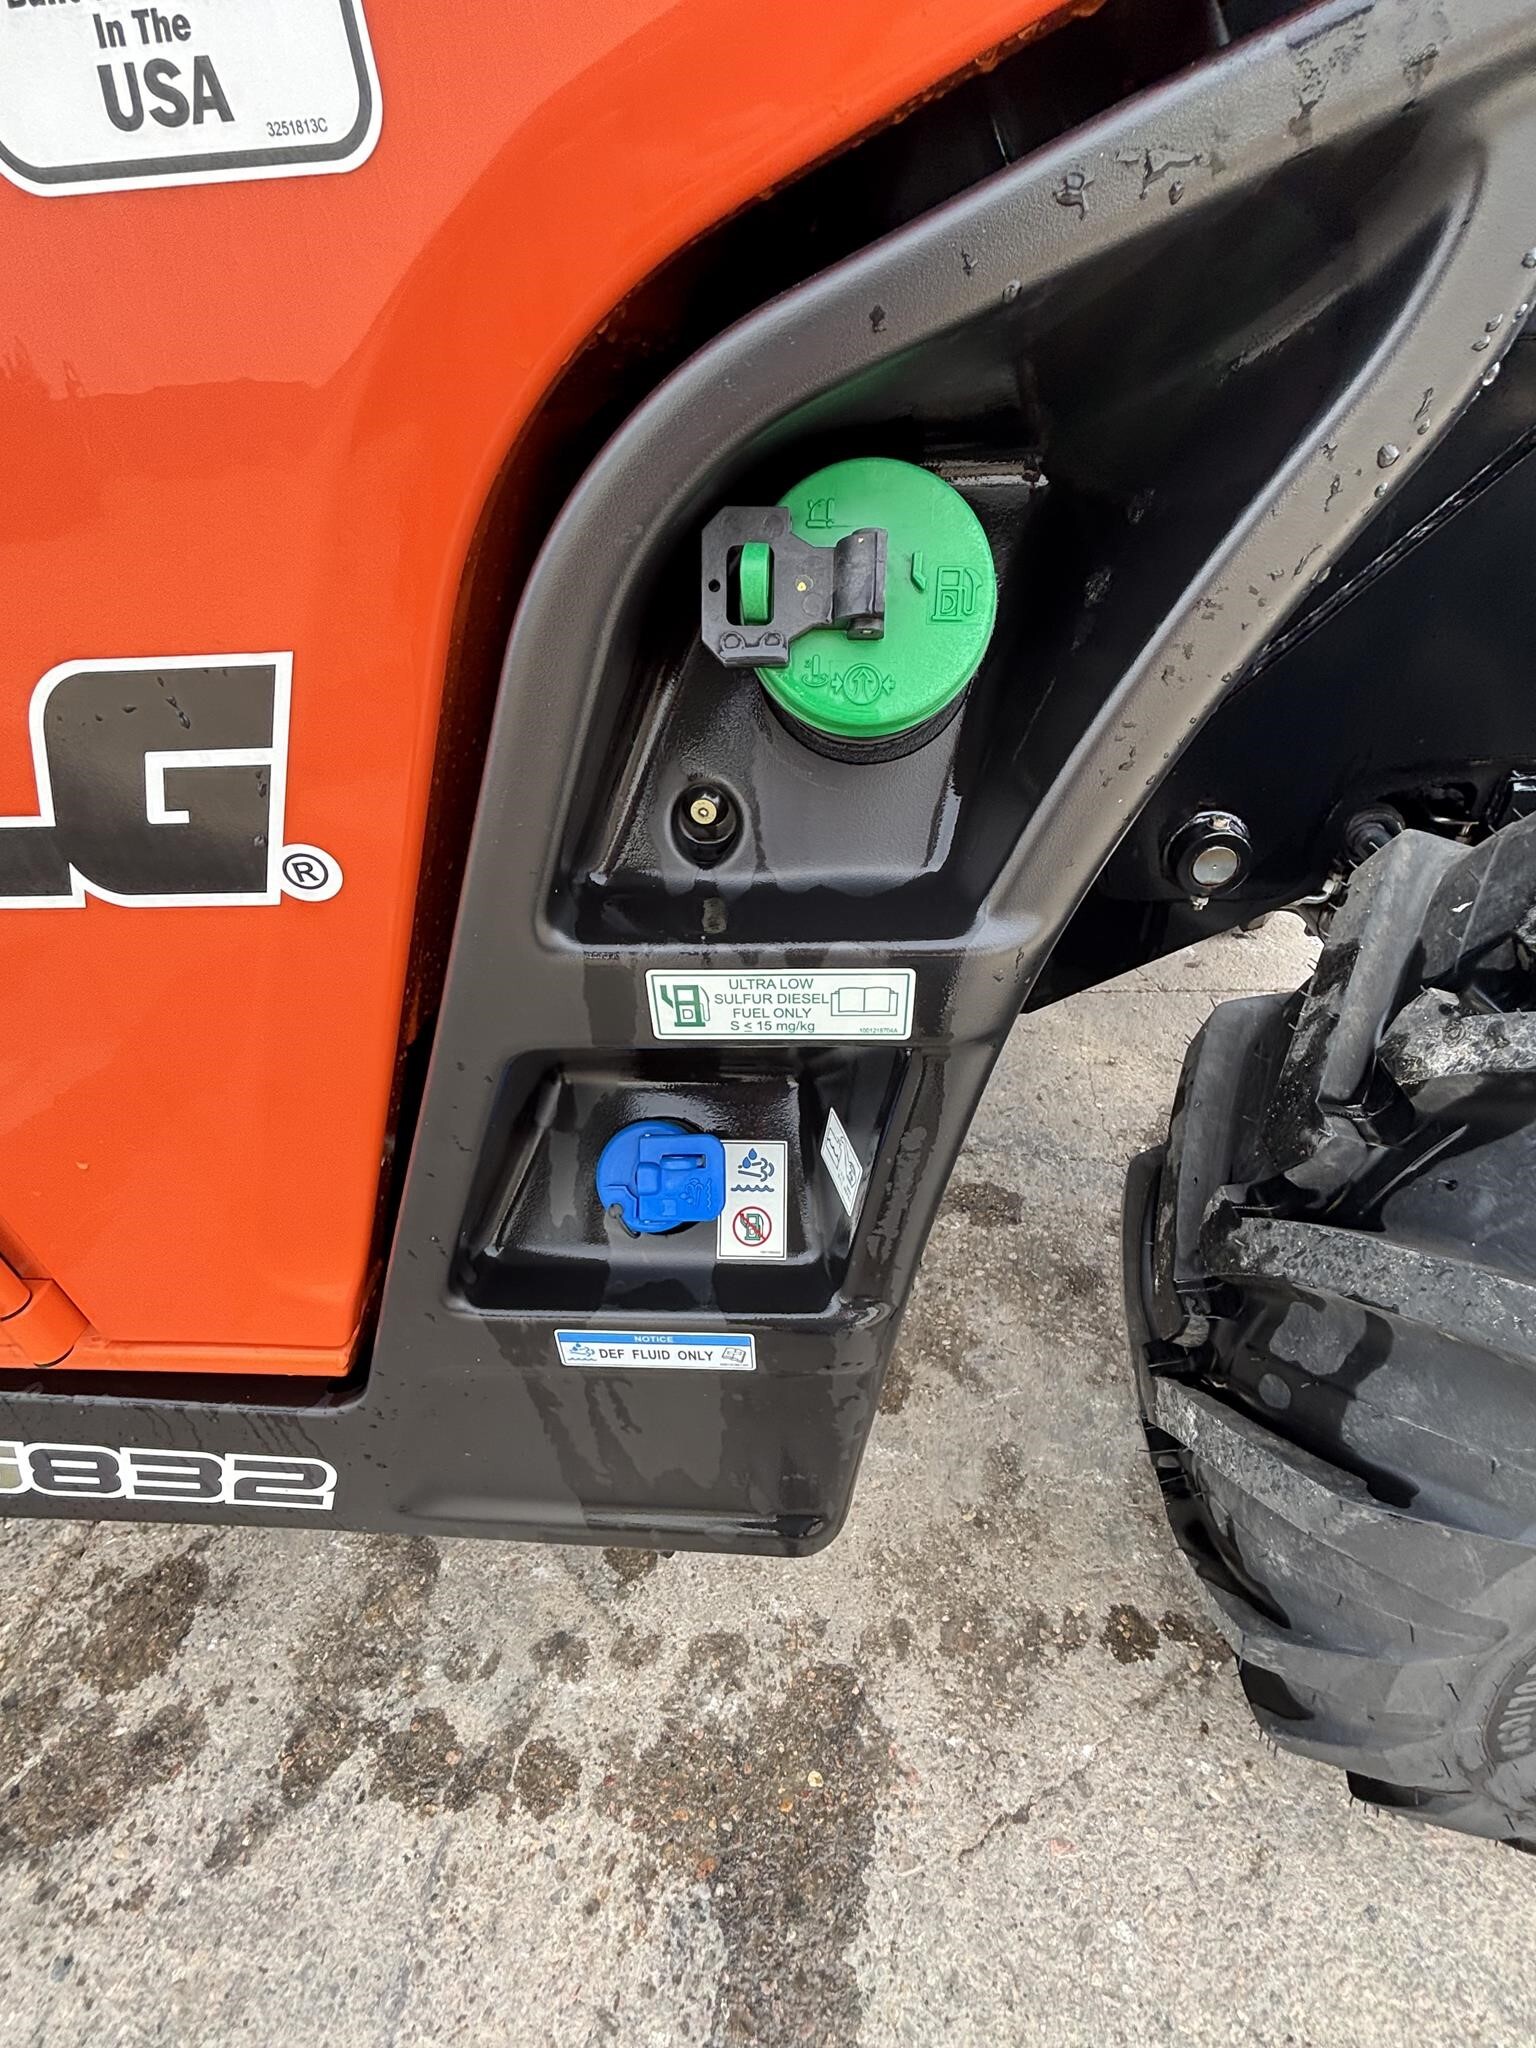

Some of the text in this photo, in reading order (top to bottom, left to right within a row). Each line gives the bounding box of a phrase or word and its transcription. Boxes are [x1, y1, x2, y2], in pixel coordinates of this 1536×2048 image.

[93, 8, 191, 49] In The
[97, 55, 235, 132] USA
[266, 118, 328, 137] 3251813C
[728, 978, 814, 990] ULTRA LOW
[714, 993, 829, 1005] SULFUR DIESEL
[733, 1007, 812, 1019] FUEL ONLY
[730, 1020, 740, 1031] S
[757, 1020, 772, 1031] 15
[776, 1020, 815, 1033] mg/kg
[633, 1335, 674, 1343] NOTICE
[599, 1348, 714, 1361] DEF FLUID ONLY
